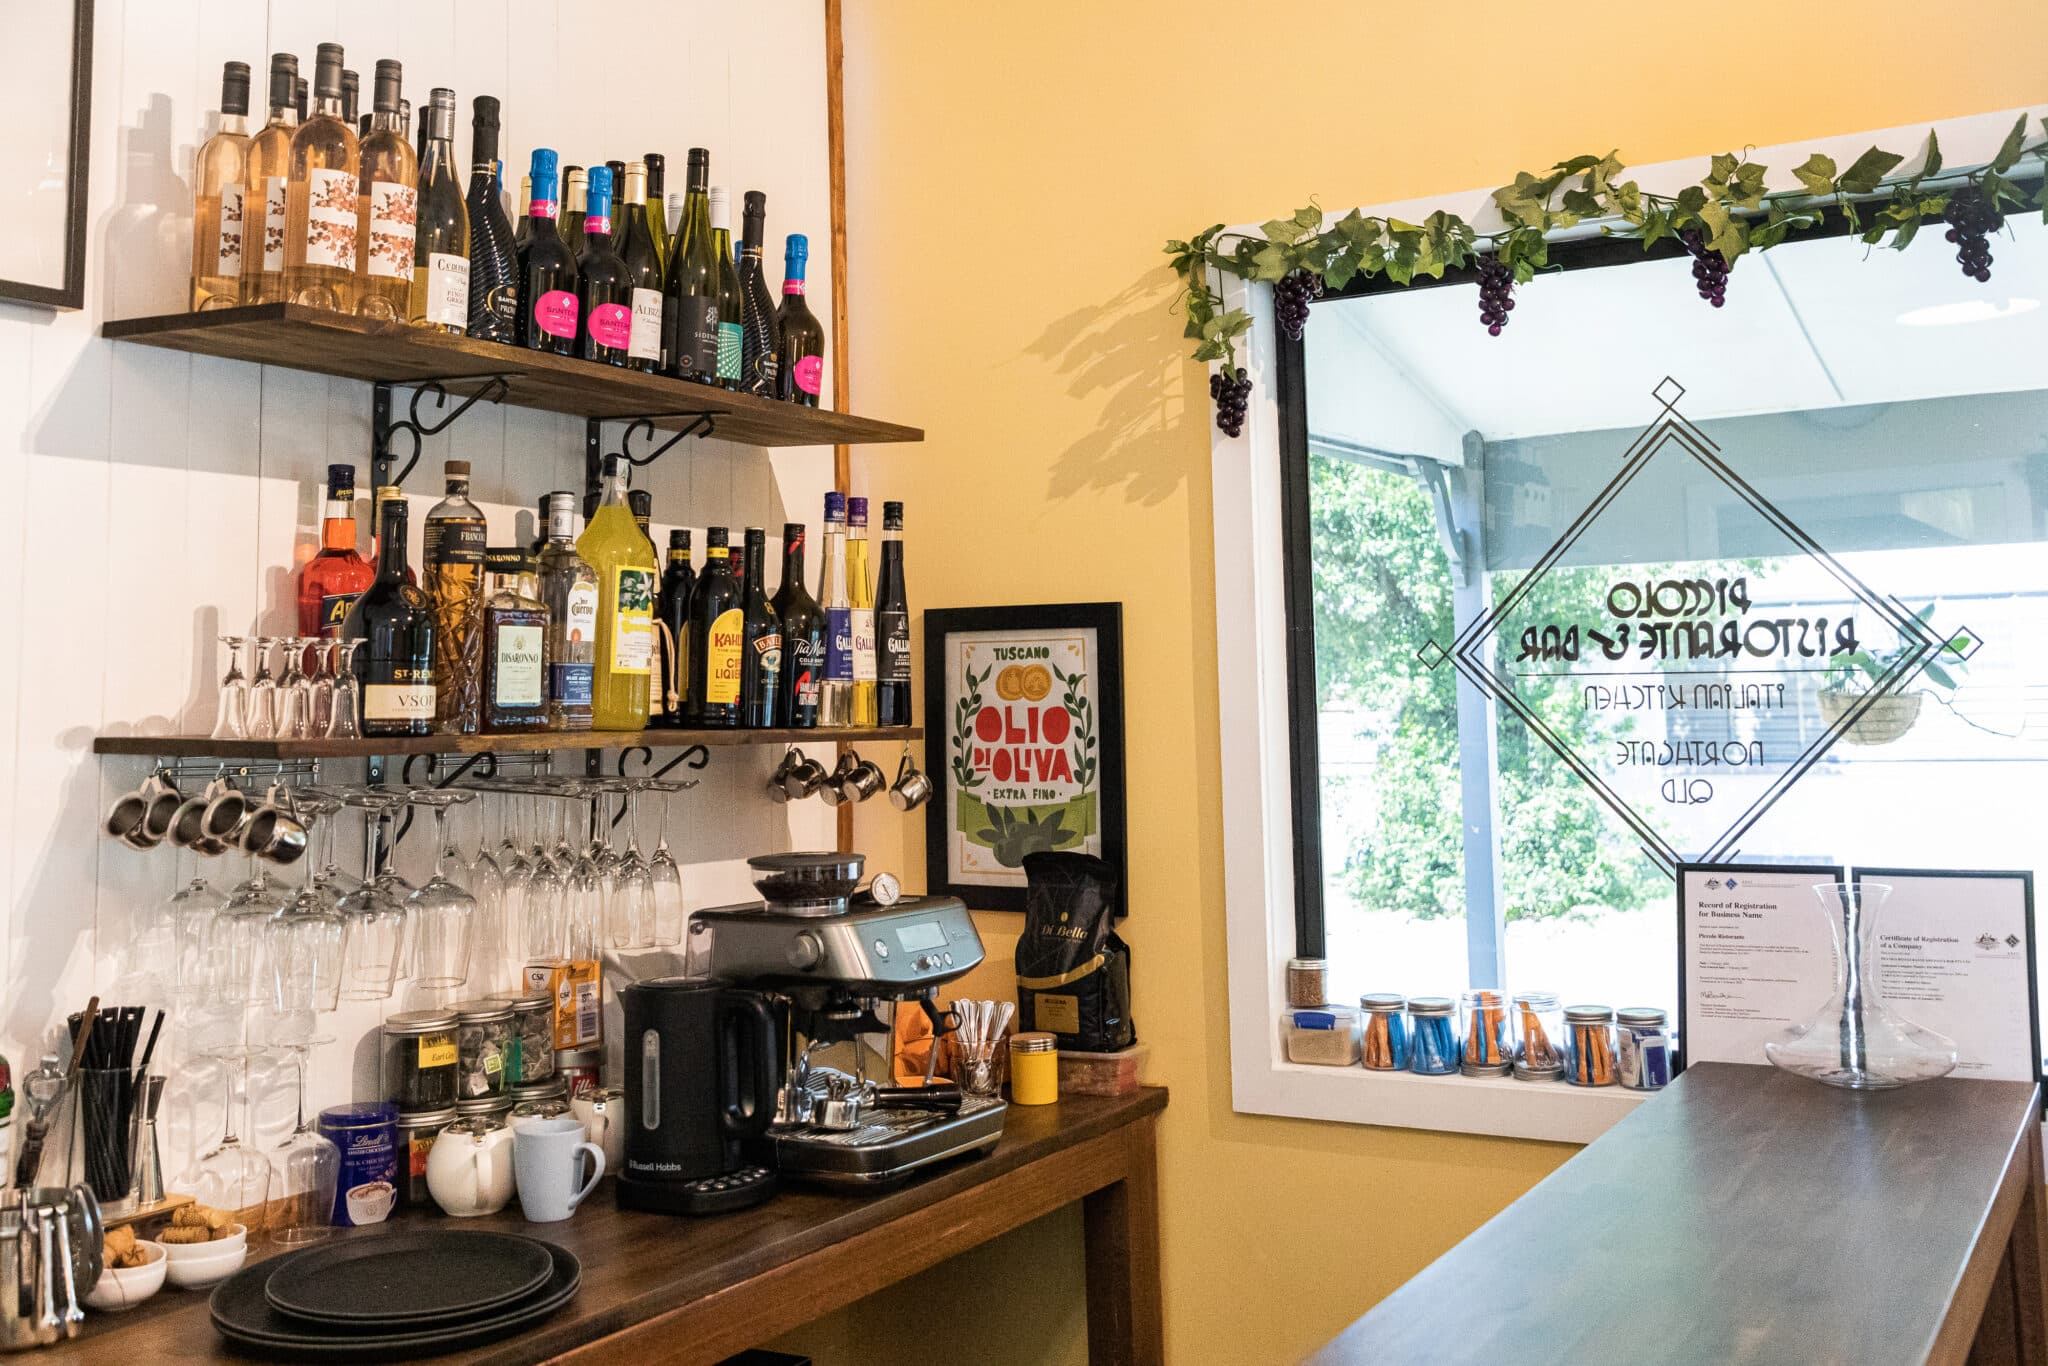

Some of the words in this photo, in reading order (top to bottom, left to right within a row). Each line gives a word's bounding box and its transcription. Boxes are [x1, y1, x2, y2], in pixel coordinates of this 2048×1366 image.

[993, 646, 1050, 661] TUSCANO
[975, 705, 1071, 745] OLIO
[974, 747, 991, 768] DI
[992, 747, 1073, 784] OLIVA
[993, 788, 1027, 800] EXTRA
[1032, 787, 1056, 800] FINO
[1698, 901, 1723, 909] Record
[1724, 901, 1733, 909] of
[1734, 902, 1778, 911] Registration
[1698, 910, 1709, 918] for
[1742, 911, 1763, 919] Name
[1056, 926, 1088, 939] Bella
[1880, 934, 1912, 942] Certificate
[531, 973, 545, 981] CSR
[629, 1159, 654, 1171] Russell
[656, 1162, 681, 1171] Hobbs
